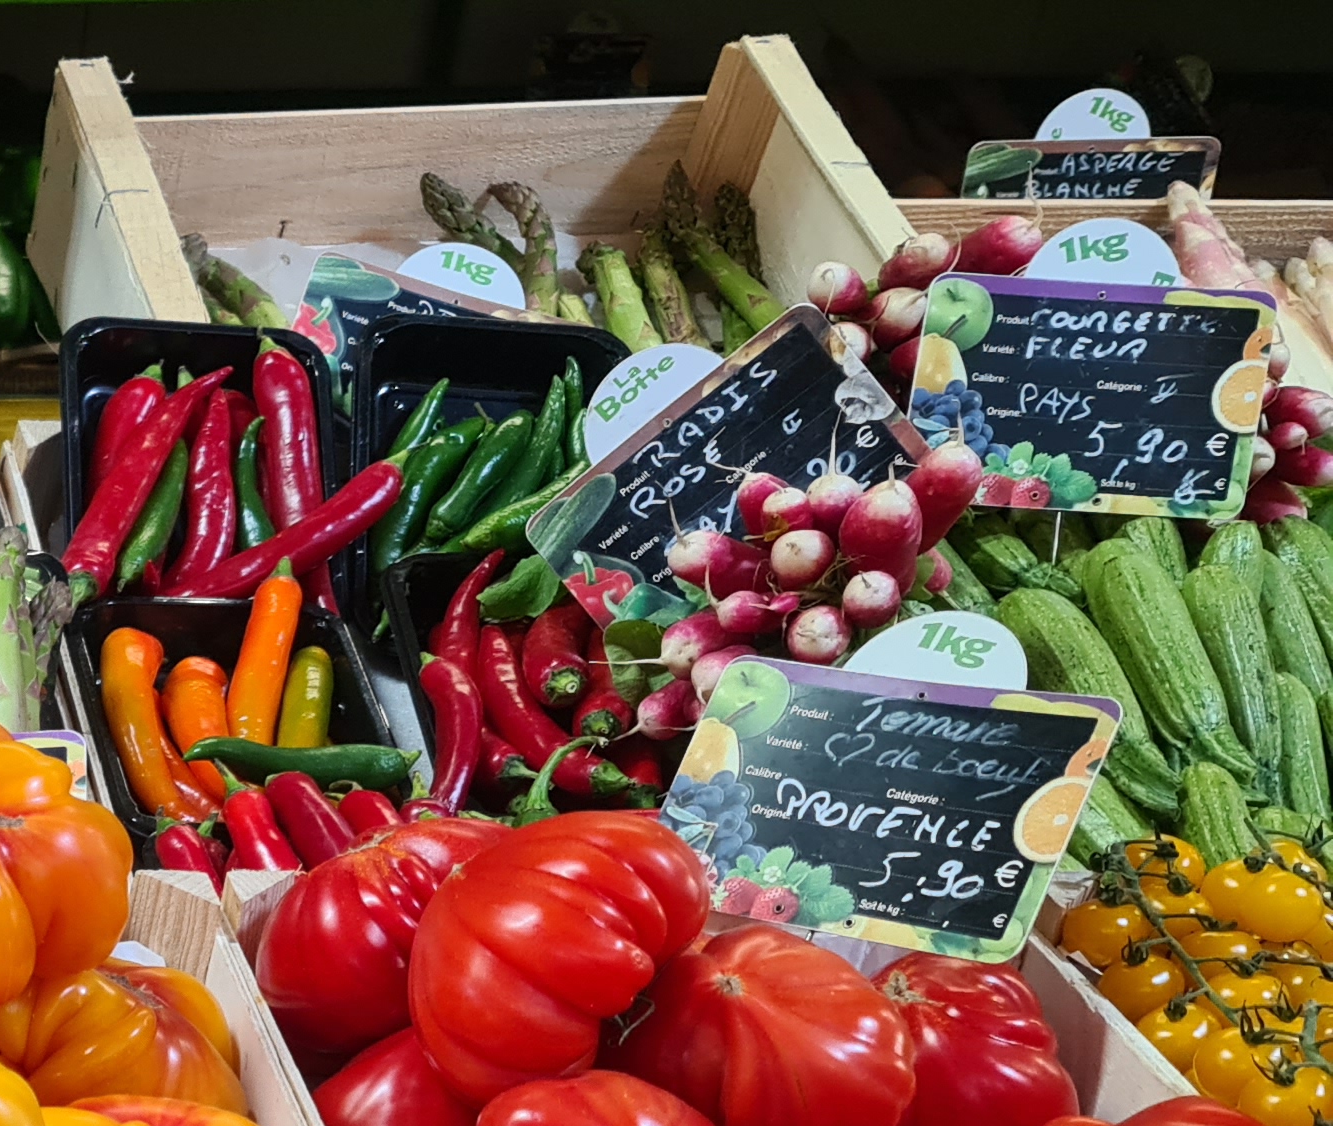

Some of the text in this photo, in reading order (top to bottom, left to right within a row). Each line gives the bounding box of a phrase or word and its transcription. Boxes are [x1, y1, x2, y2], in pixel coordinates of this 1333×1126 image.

[1090, 97, 1135, 133] 1kg
[1062, 152, 1184, 176] ASPERGE
[1058, 233, 1129, 264] 1kg
[441, 250, 497, 286] 1kg
[594, 355, 675, 423] Botte
[613, 365, 642, 389] La
[634, 361, 778, 468] RADIS
[1019, 384, 1096, 425] PAYS
[855, 425, 879, 449] €
[1206, 433, 1229, 456] €
[628, 427, 726, 519] ROSE
[917, 622, 997, 669] 1kg
[776, 777, 1001, 852] PROVENCE
[994, 861, 1024, 889] €
[992, 913, 1007, 928] €
